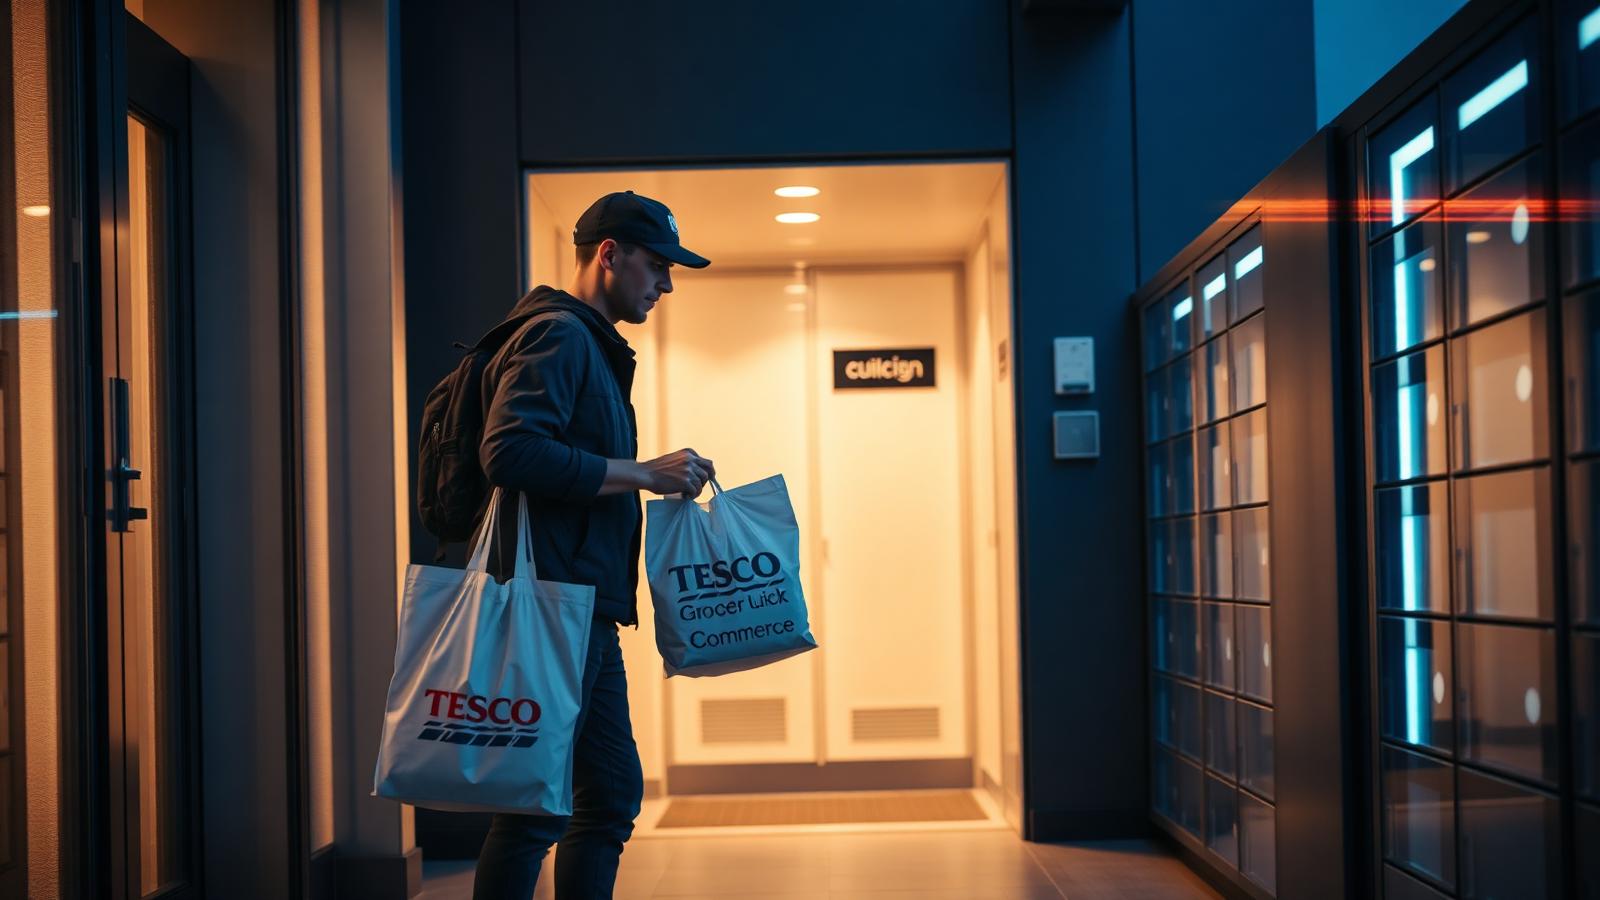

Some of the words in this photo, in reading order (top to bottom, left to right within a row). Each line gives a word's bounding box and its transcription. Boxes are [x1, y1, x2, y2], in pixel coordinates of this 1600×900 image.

[668, 552, 781, 593] TESCO
[680, 598, 744, 622] Grocer
[690, 619, 794, 649] Commerce
[425, 689, 541, 726] TESCO
